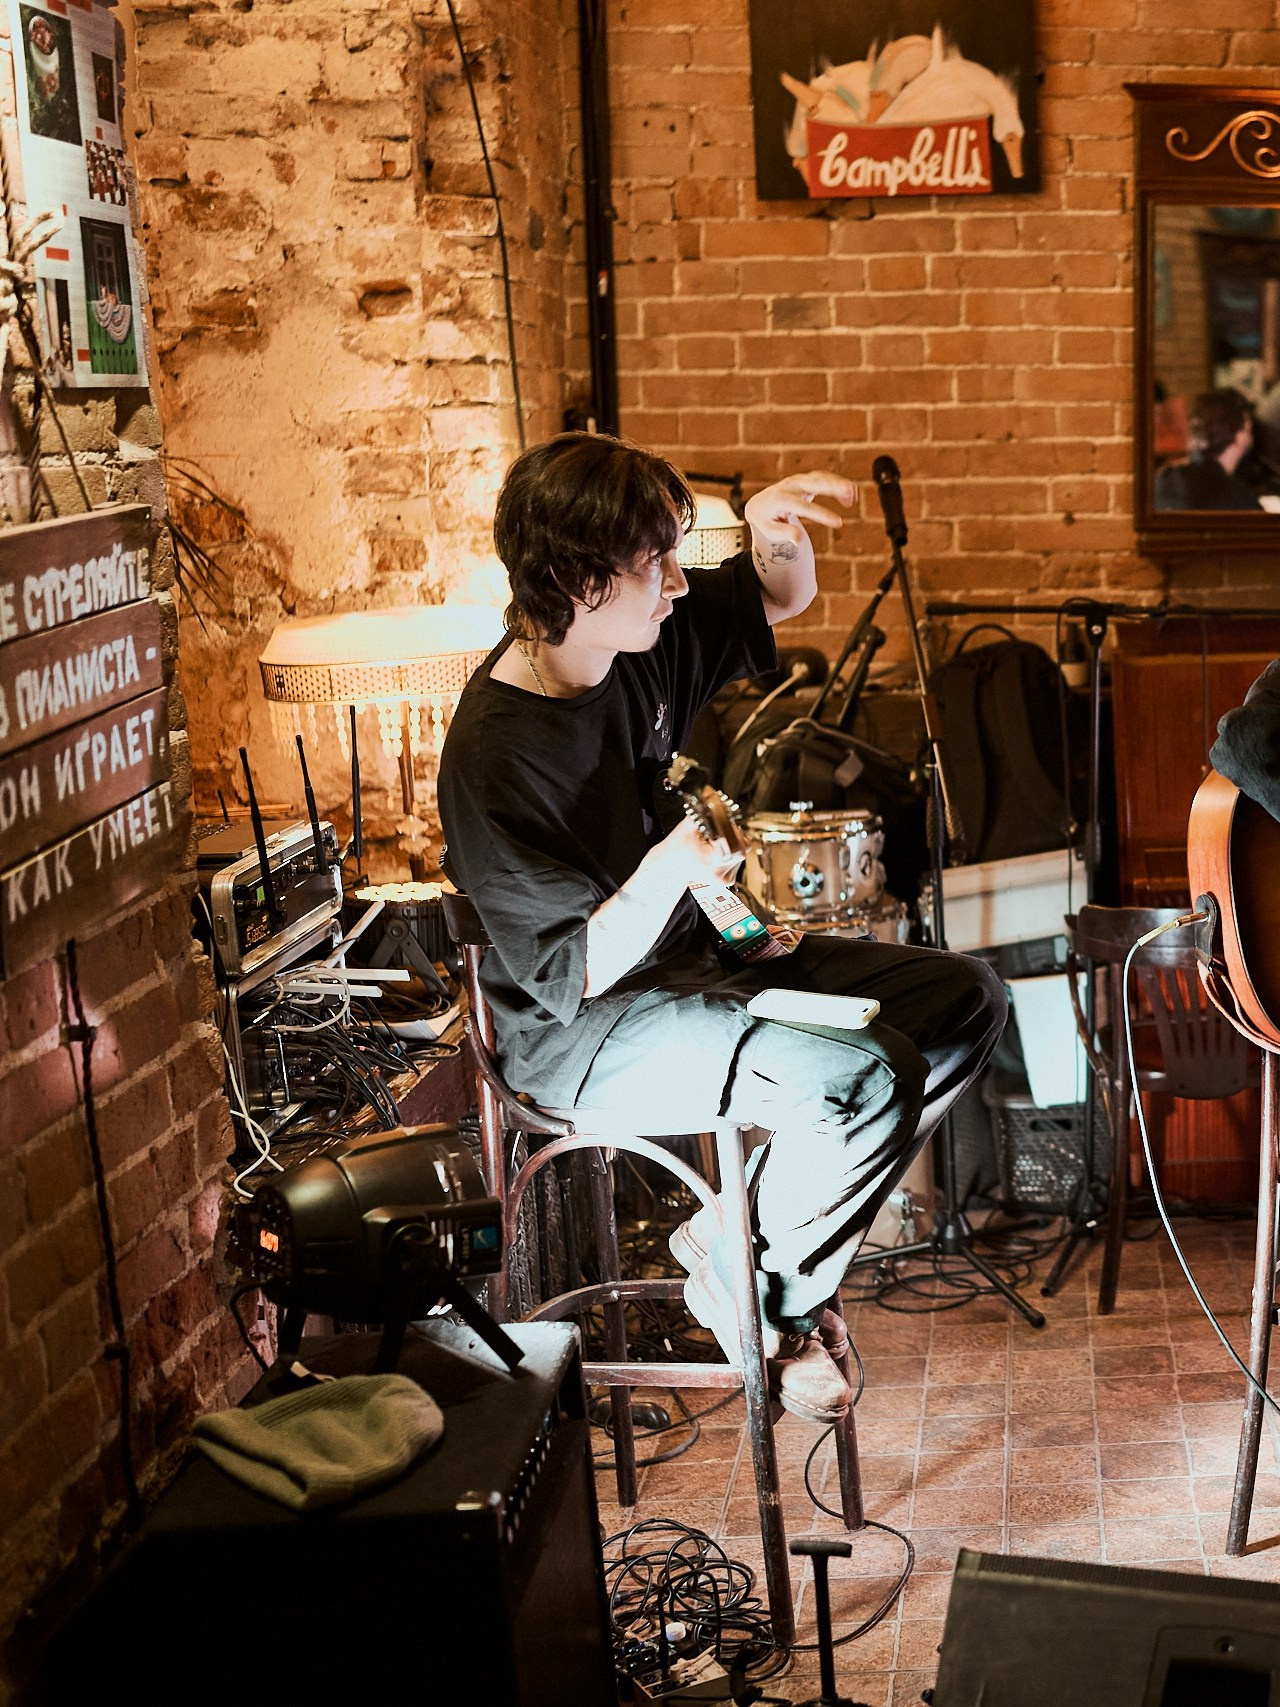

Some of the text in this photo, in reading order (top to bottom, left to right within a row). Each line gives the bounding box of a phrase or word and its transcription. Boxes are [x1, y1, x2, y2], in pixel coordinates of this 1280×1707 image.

[0, 542, 151, 643] Е СТРЕЛЯЙТЕ
[15, 634, 141, 730] ПИАНИСТА
[0, 764, 40, 833] ОН
[8, 781, 174, 925] КАК УМЕЕТ
